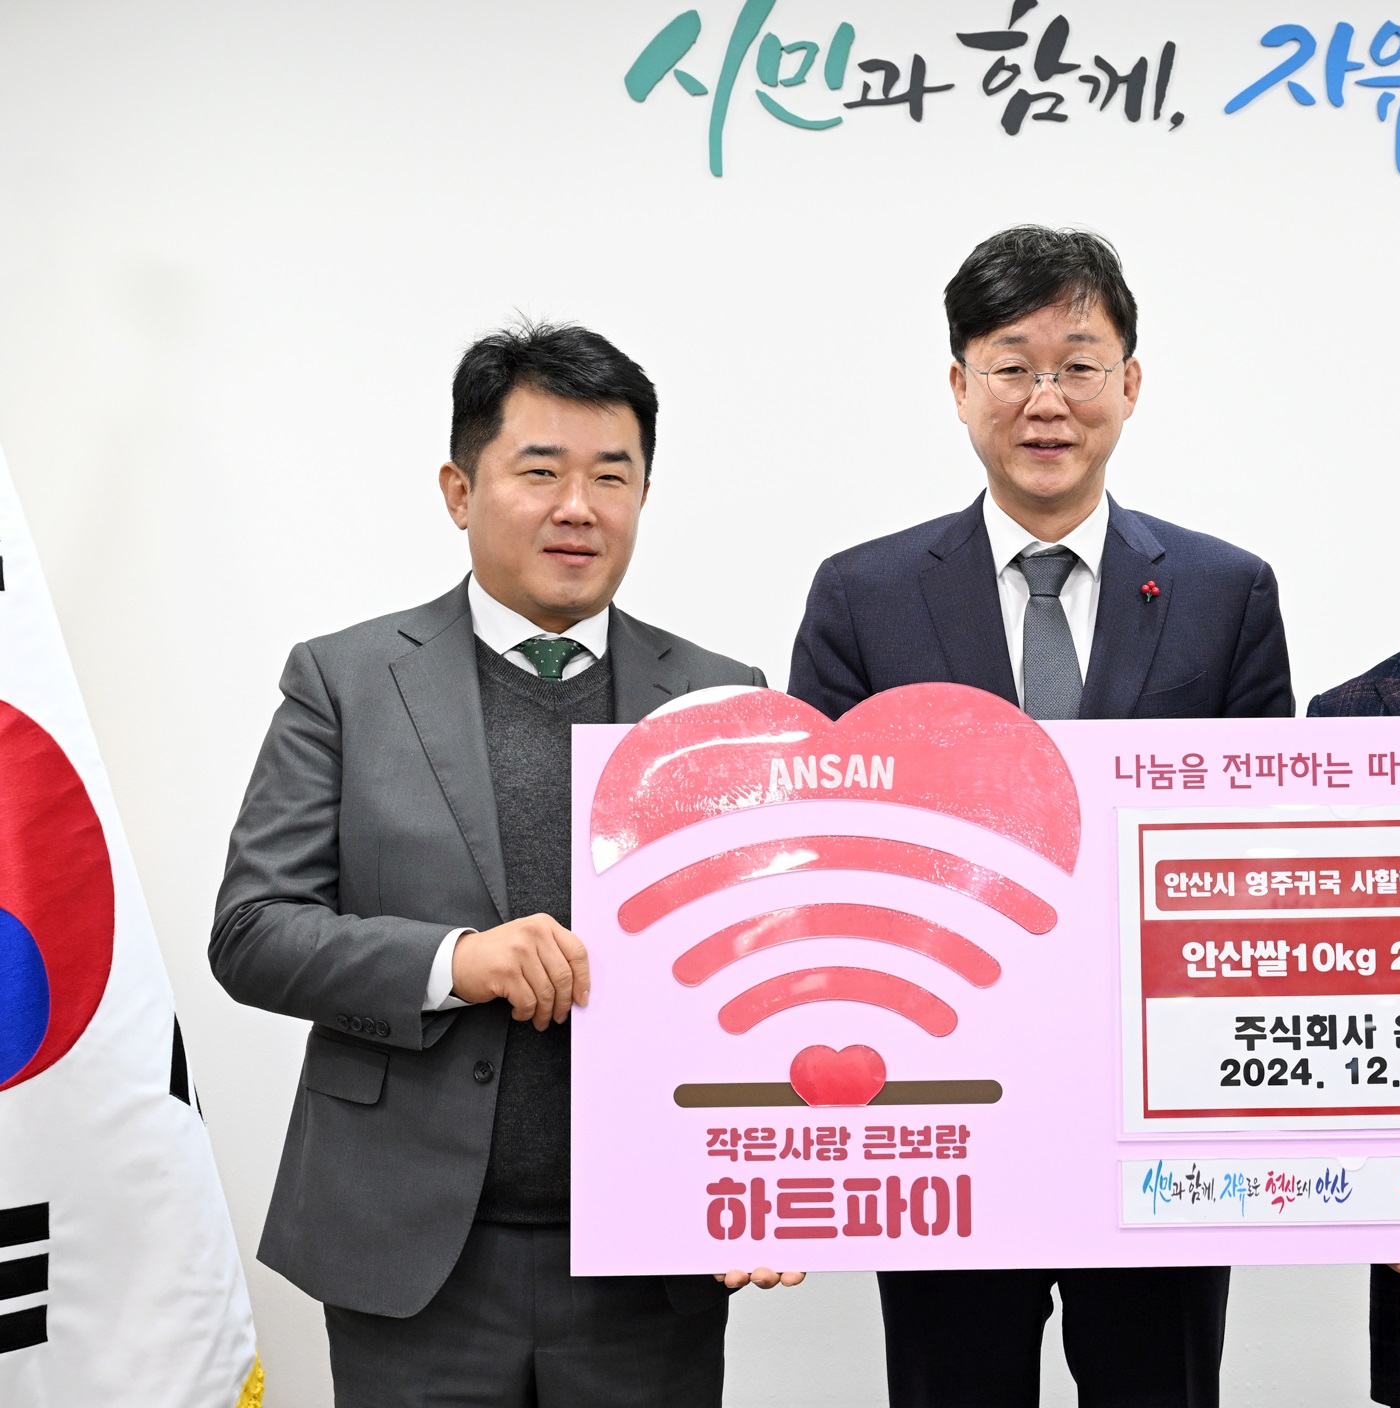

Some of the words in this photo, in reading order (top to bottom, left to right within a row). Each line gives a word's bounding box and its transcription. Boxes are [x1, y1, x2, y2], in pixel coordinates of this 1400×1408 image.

[624, 0, 955, 177] 시민과
[956, 0, 1184, 136] 함께,
[769, 754, 894, 790] ANSAN
[1115, 753, 1208, 790] 나눔을
[1223, 753, 1353, 789] 전파하는
[1164, 872, 1235, 897] 안산시
[1245, 870, 1341, 896] 영주귀국
[1182, 940, 1376, 978] 안산쌀10kg
[1235, 1014, 1376, 1051] 주식회사
[1220, 1058, 1324, 1088] 2024.
[1345, 1056, 1400, 1087] 12.
[706, 1126, 851, 1162] 작은사랑
[862, 1125, 970, 1160] 큰보람
[1143, 1159, 1185, 1215] 시민과
[1186, 1163, 1216, 1204] 함께,
[1220, 1173, 1260, 1217] 자유로운
[1265, 1171, 1311, 1214] 혁신도시
[1316, 1168, 1352, 1203] 안산
[706, 1174, 972, 1241] 하트파이
